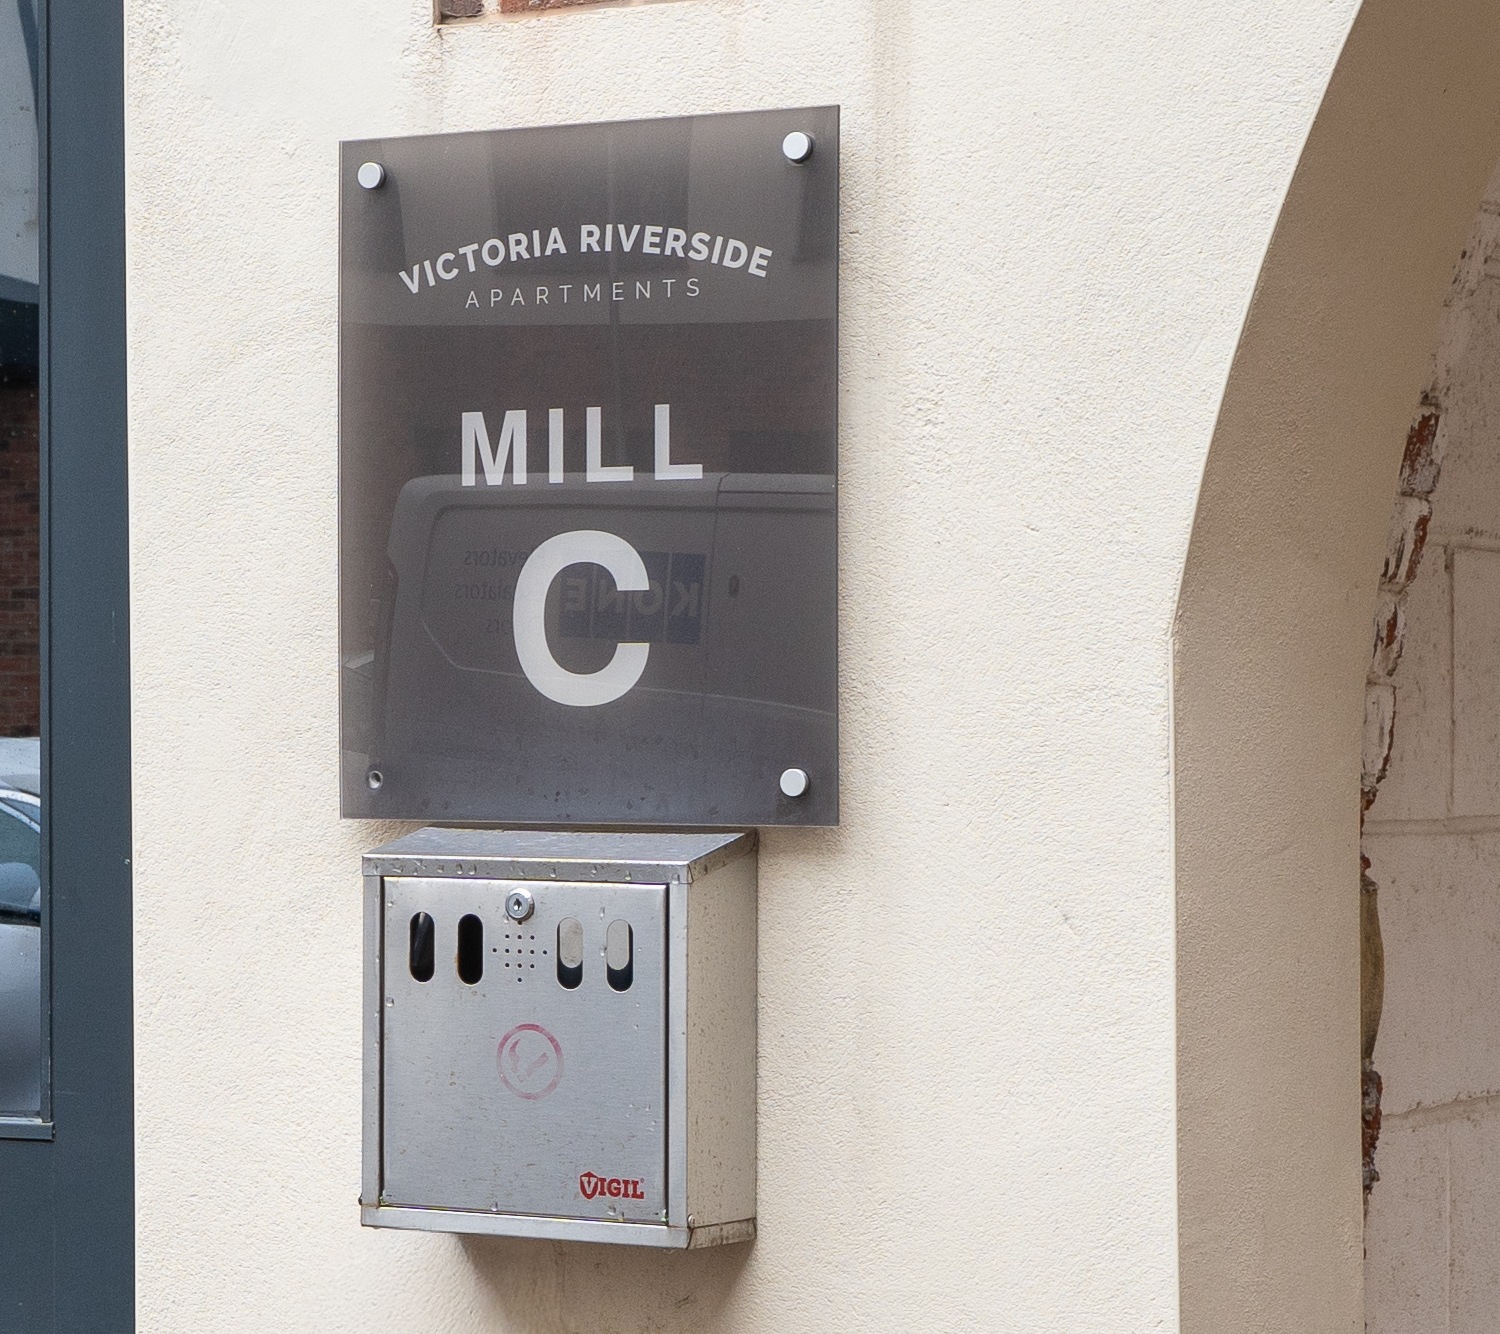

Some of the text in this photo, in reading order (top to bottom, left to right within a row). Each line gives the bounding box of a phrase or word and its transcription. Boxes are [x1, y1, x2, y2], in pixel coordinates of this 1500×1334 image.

[398, 224, 773, 294] VICTORIA RIVERSIDE
[465, 278, 700, 308] APARTMENTS
[461, 403, 703, 486] MILL
[513, 530, 650, 707] C
[580, 1172, 644, 1200] VIGIL
